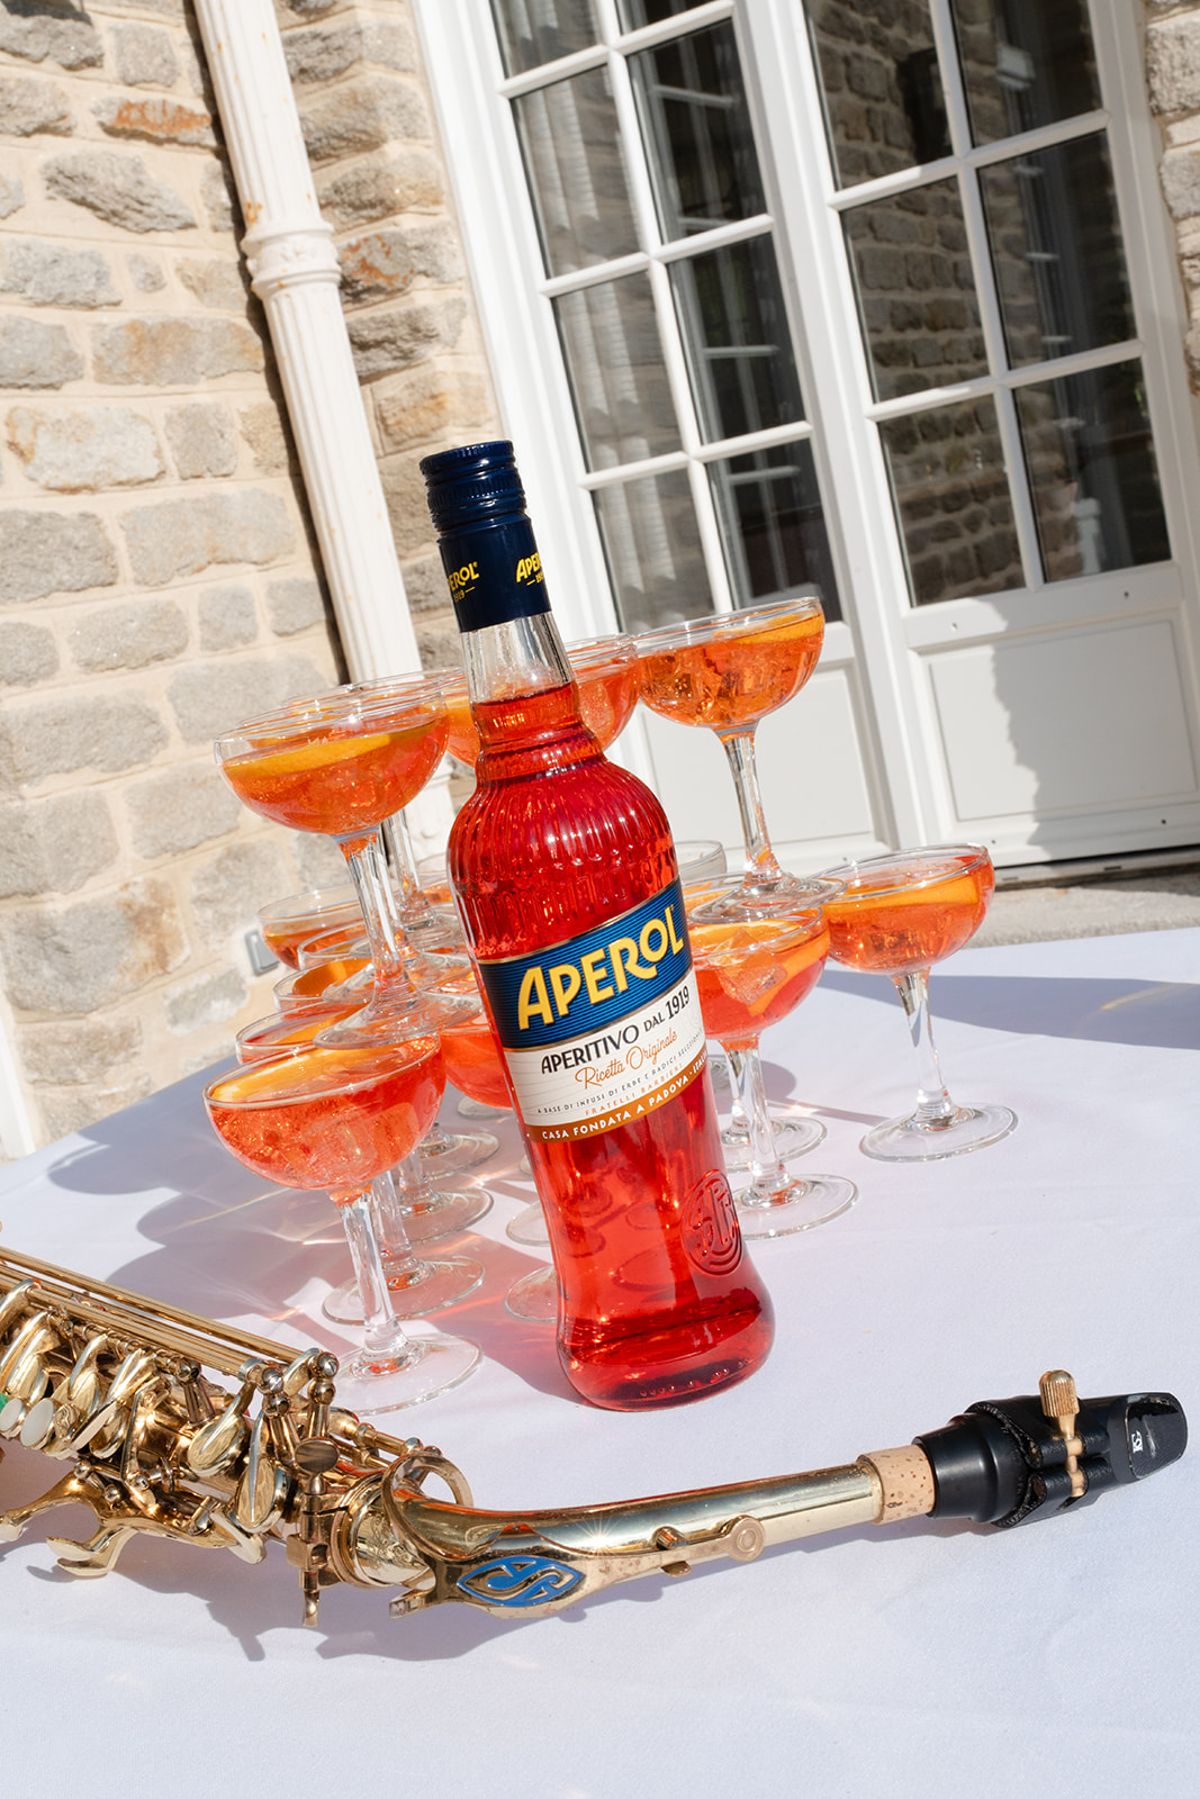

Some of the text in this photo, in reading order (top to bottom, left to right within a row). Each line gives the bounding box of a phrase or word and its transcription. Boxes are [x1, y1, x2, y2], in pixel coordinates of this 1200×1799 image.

[516, 552, 542, 583] APE
[517, 906, 685, 1031] APEROL
[541, 985, 690, 1074] APERITIVO DAL 1919
[575, 1026, 678, 1090] Ricetta Originale
[542, 1129, 569, 1140] CASA
[572, 1110, 632, 1136] FONDATA
[636, 1103, 645, 1115] A
[648, 1074, 689, 1107] PADOVA
[564, 1103, 573, 1111] DI
[608, 1088, 618, 1097] DI
